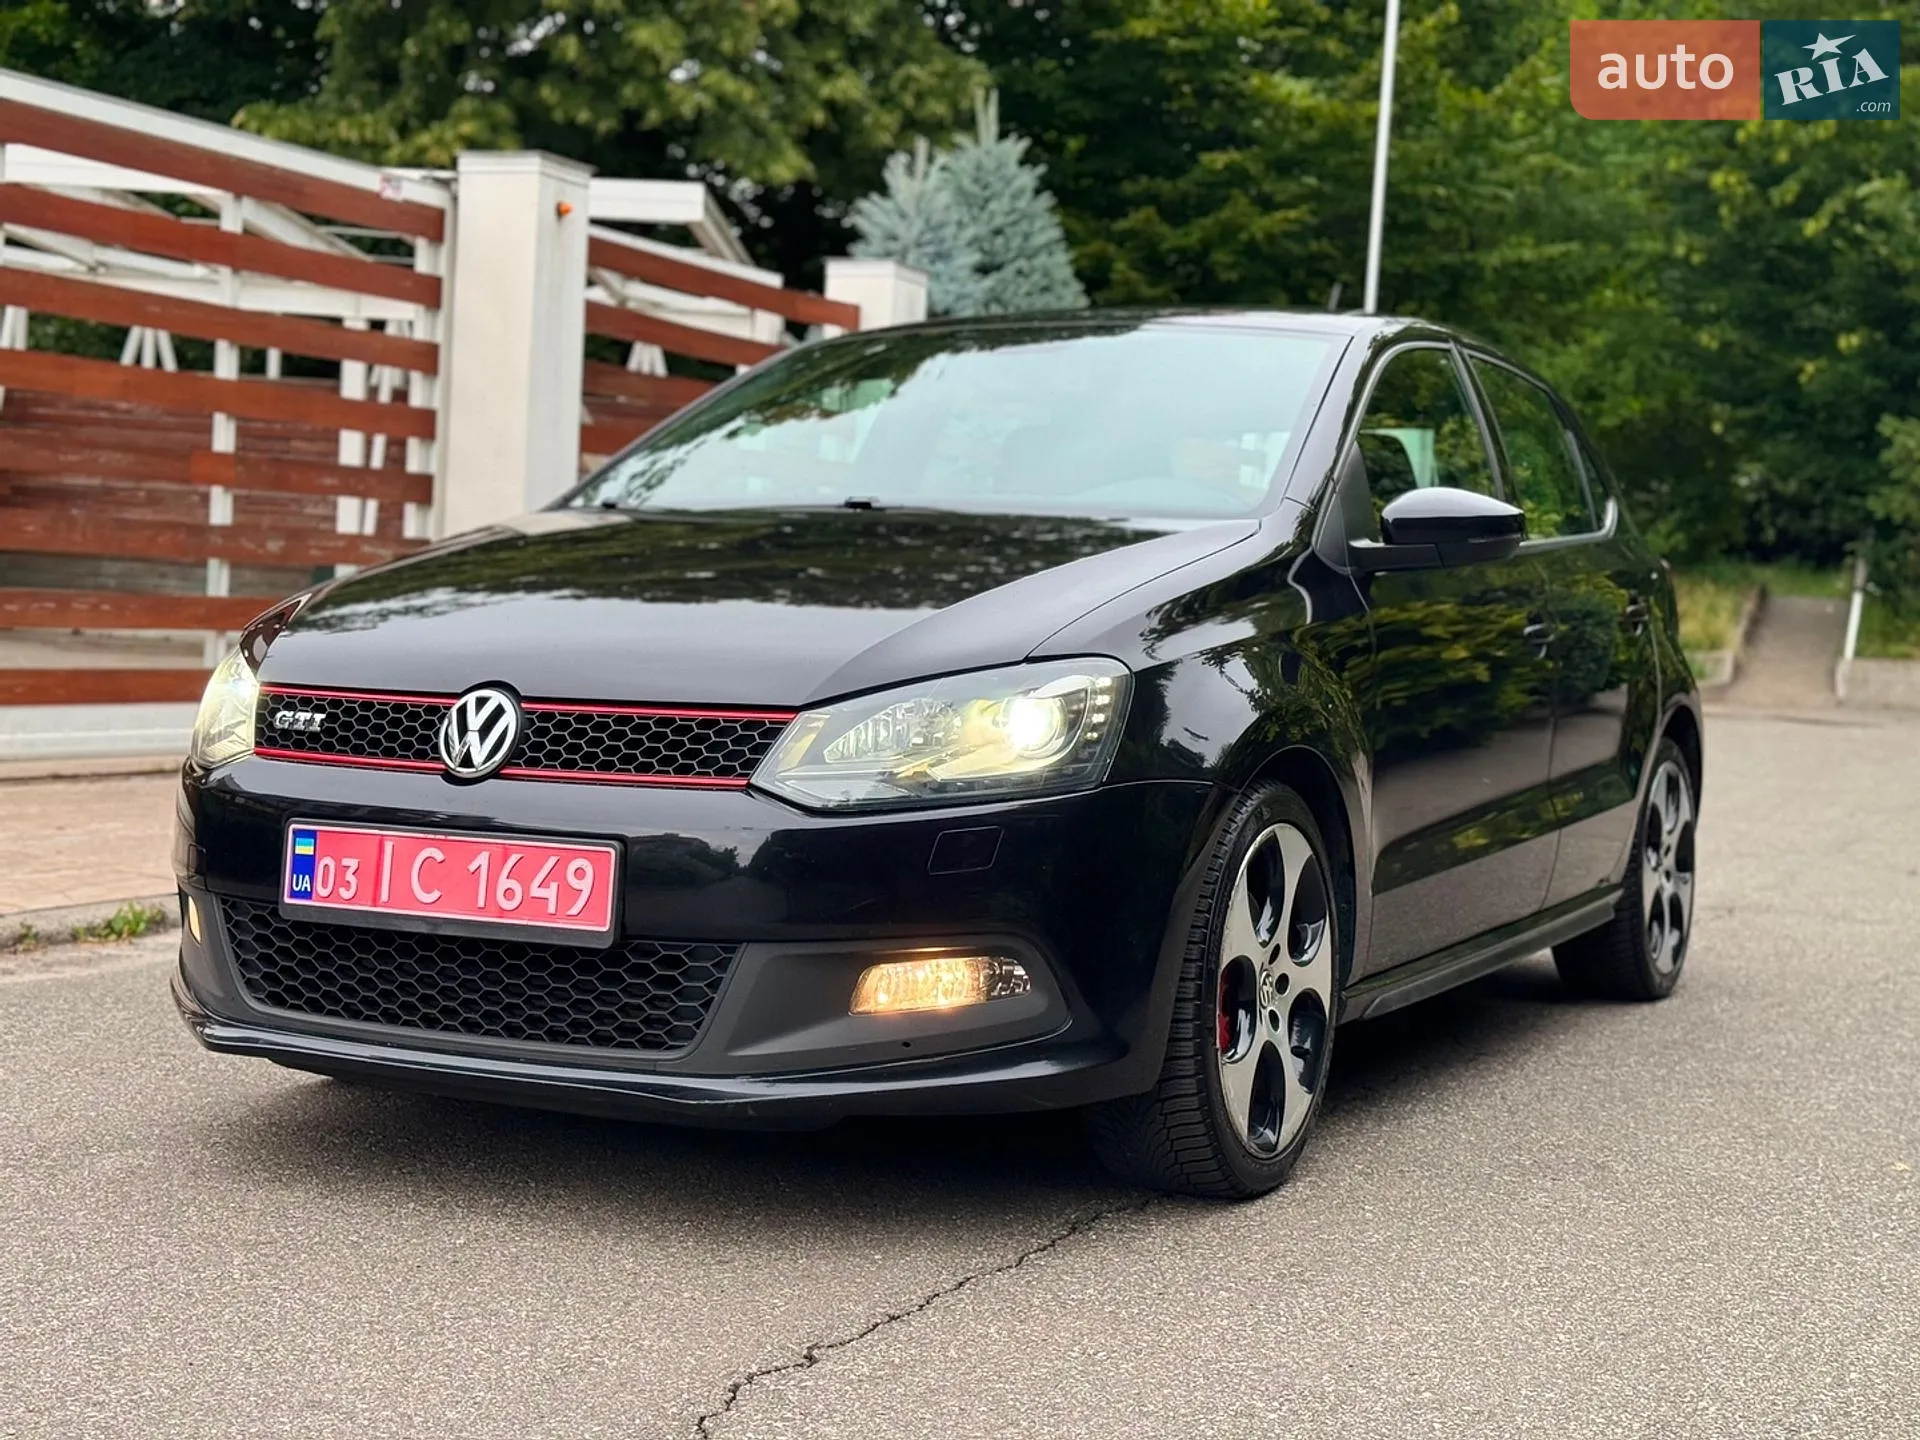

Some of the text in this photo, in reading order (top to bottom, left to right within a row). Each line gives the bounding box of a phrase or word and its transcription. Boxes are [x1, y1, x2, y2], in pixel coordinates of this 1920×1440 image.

[274, 710, 326, 732] GTI
[292, 874, 312, 892] UA
[315, 856, 359, 900] 03
[466, 850, 595, 917] 1649
